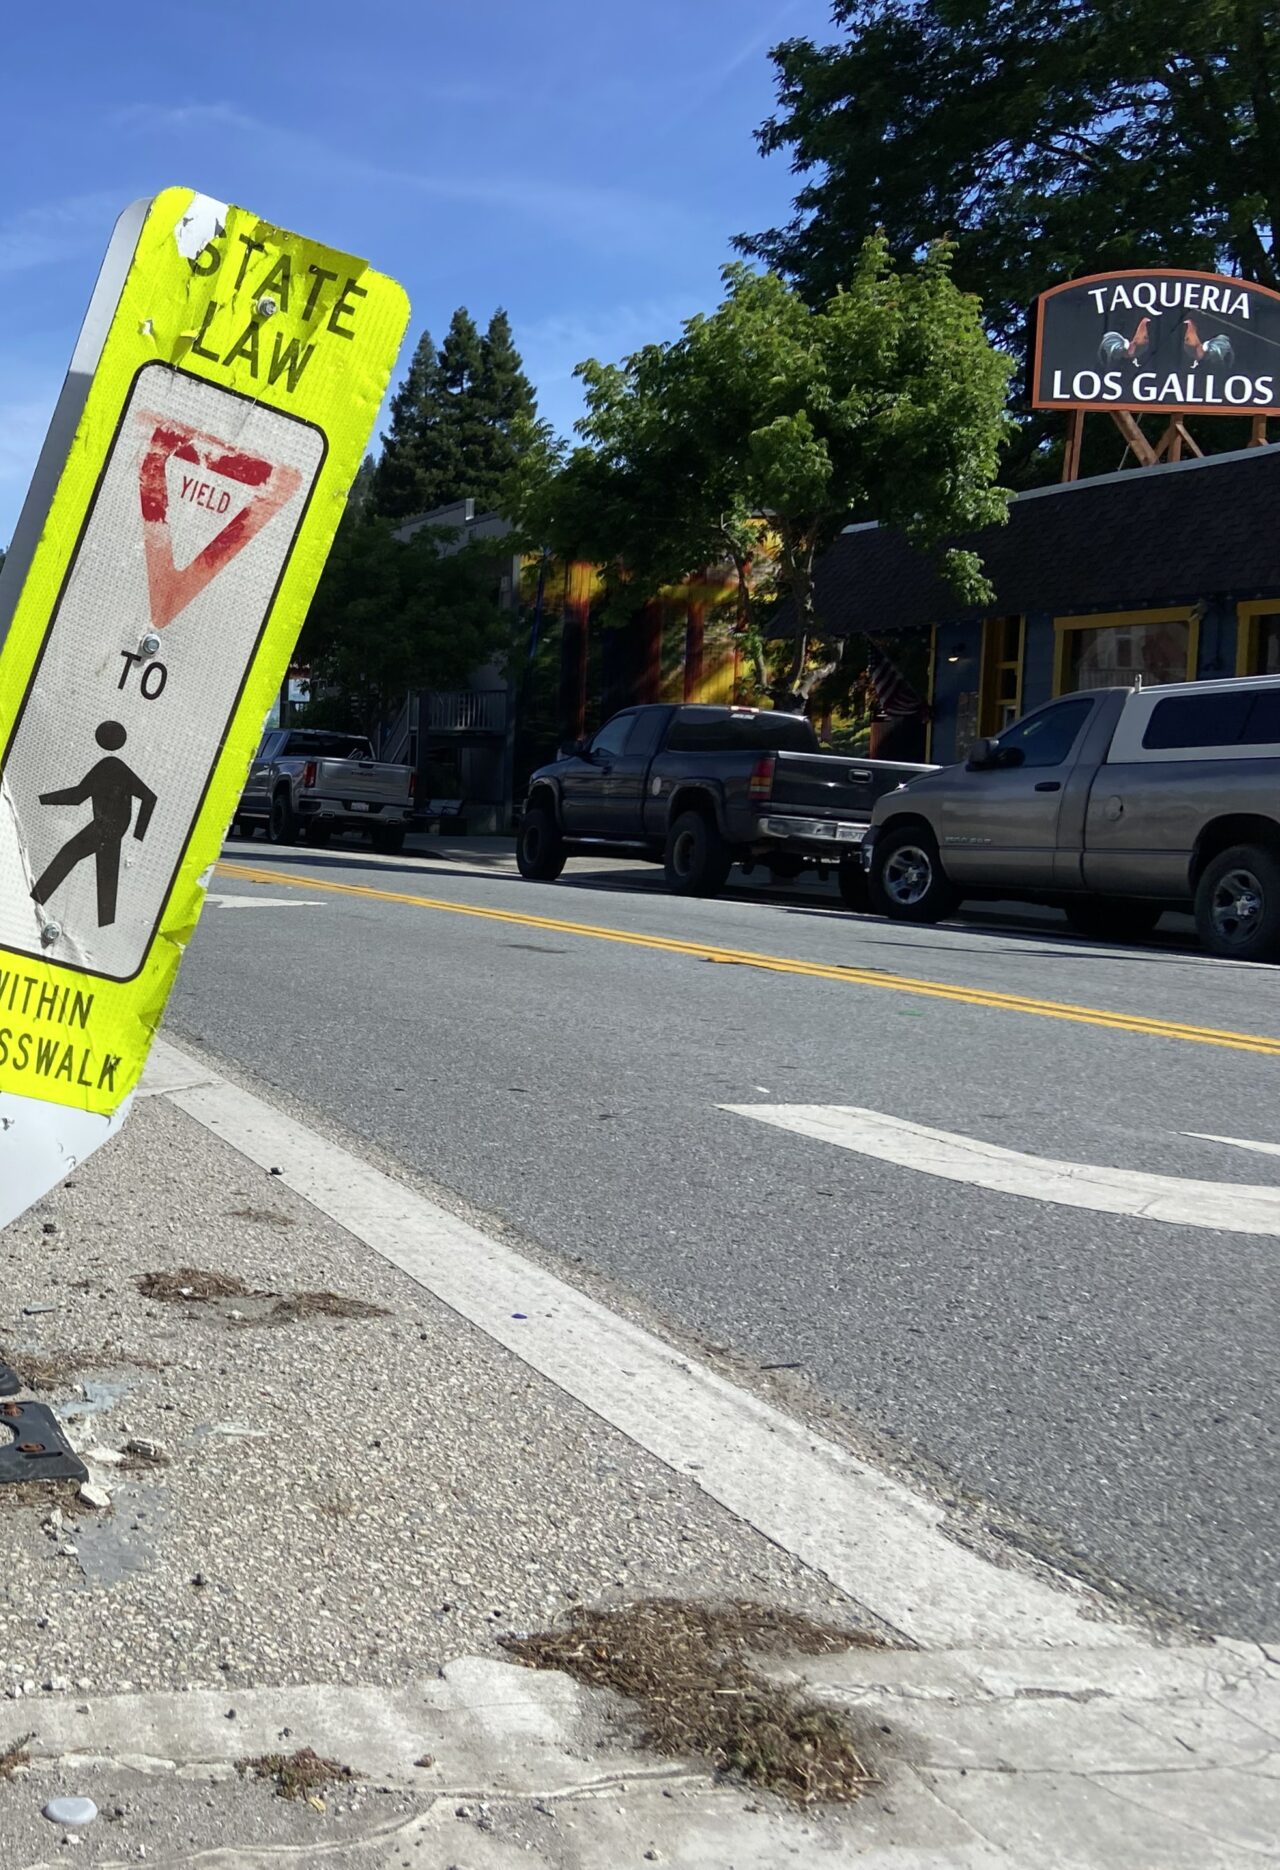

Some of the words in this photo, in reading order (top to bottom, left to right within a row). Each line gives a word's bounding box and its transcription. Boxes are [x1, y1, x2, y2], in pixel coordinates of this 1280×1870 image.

[188, 218, 368, 341] STATE
[1088, 281, 1250, 320] TAQUERIA
[191, 301, 315, 394] LAW
[1052, 370, 1122, 401] LOS
[1132, 372, 1274, 405] GALLOS
[180, 475, 231, 514] YIELD
[117, 650, 168, 700] TO
